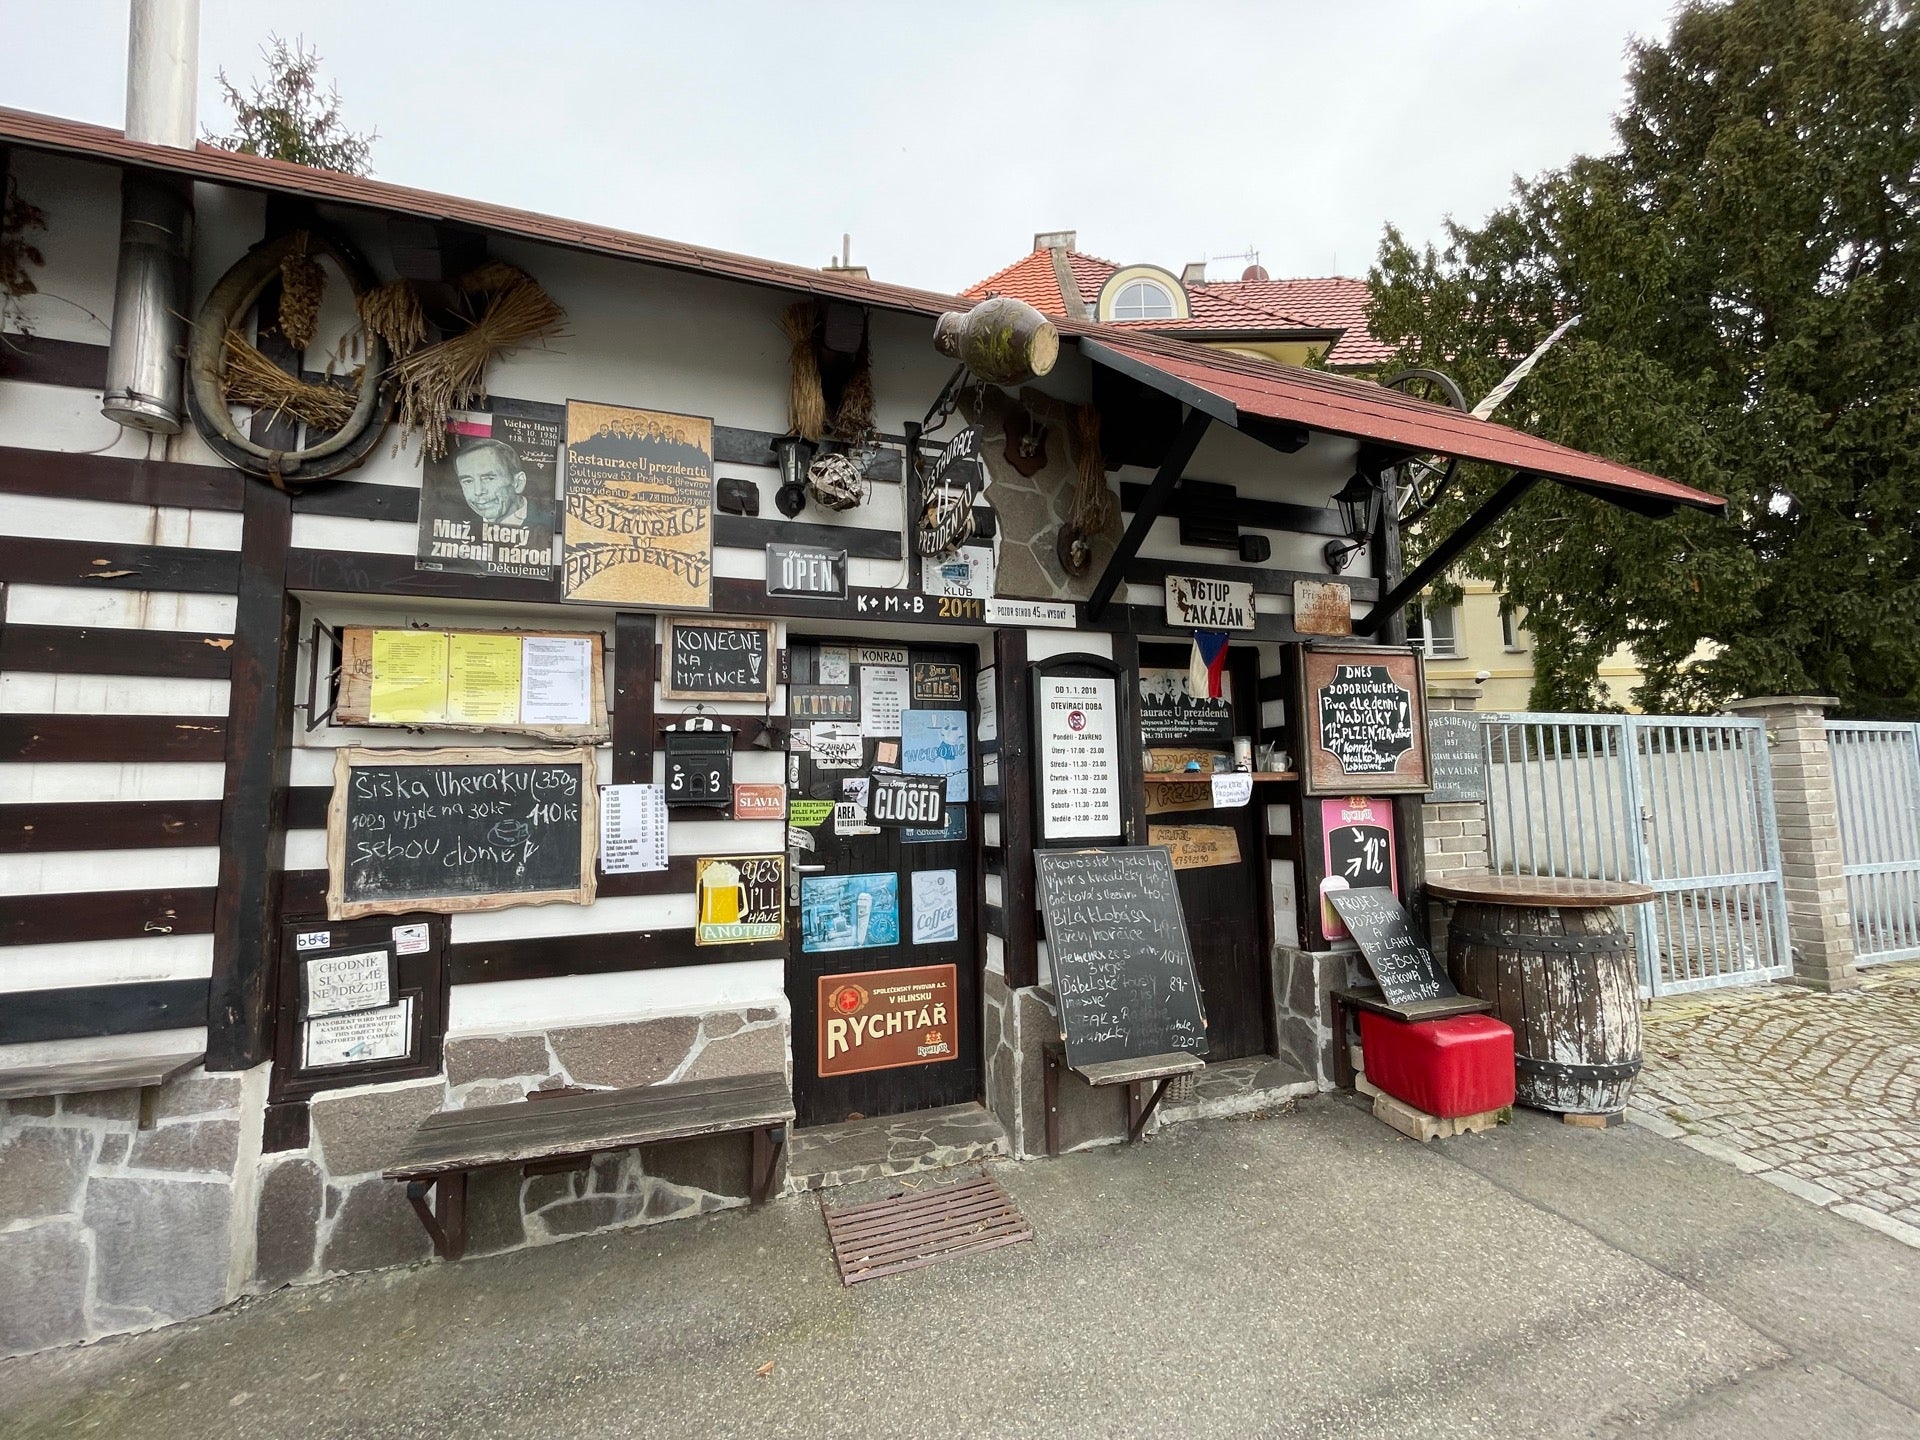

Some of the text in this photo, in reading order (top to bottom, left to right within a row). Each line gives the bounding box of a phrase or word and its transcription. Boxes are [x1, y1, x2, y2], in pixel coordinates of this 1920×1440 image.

[504, 419, 558, 433] Václav Havel
[540, 431, 558, 440] 1936
[540, 439, 556, 447] 2011
[568, 450, 638, 470] Restaurace
[639, 457, 647, 470] U
[925, 430, 975, 496] ESTAURACE
[620, 471, 631, 481] 53
[936, 478, 952, 525] U
[566, 494, 706, 536] RESTAURACE
[433, 519, 530, 547] Muž, který
[629, 535, 656, 549] U
[431, 540, 551, 566] změnil národ
[487, 562, 550, 577] Děkujeme!
[564, 549, 702, 597] PREZIDENTŮ
[783, 557, 832, 592] OPEN
[944, 586, 973, 597] KLUB
[1190, 582, 1230, 602] VSTUP
[938, 597, 982, 619] 2011
[997, 606, 1014, 616] POZOR
[1032, 606, 1041, 618] 45
[1047, 608, 1067, 619] VYSOKÝ
[677, 653, 701, 666] NA
[862, 650, 904, 663] KONRAD
[1346, 666, 1372, 678] DNES
[1055, 686, 1064, 694] OD
[1050, 701, 1103, 710] OTEVÍRACÍ DOBA
[1323, 696, 1348, 710] Piva
[1140, 706, 1229, 720] taurace U prezidentů
[817, 743, 857, 751] ZAHRADA
[1434, 767, 1446, 776] AN
[671, 770, 721, 792] 5 3
[740, 797, 780, 807] SLAVIA
[874, 788, 940, 822] CLOSED
[837, 806, 856, 819] AREA
[741, 859, 780, 887] YES
[750, 887, 780, 911] I'LL
[747, 911, 780, 923] HAVE
[917, 907, 954, 930] Coffee
[704, 925, 778, 939] ANOTHER
[1372, 927, 1383, 938] A
[319, 955, 378, 973] CHODNÍK
[338, 974, 347, 983] V
[873, 985, 912, 995] SPOLEČENSKÝ
[912, 983, 936, 991] PIVOVAR
[889, 991, 932, 1004] V HLINSKU
[827, 1002, 948, 1060] RYCHTÁŘ
